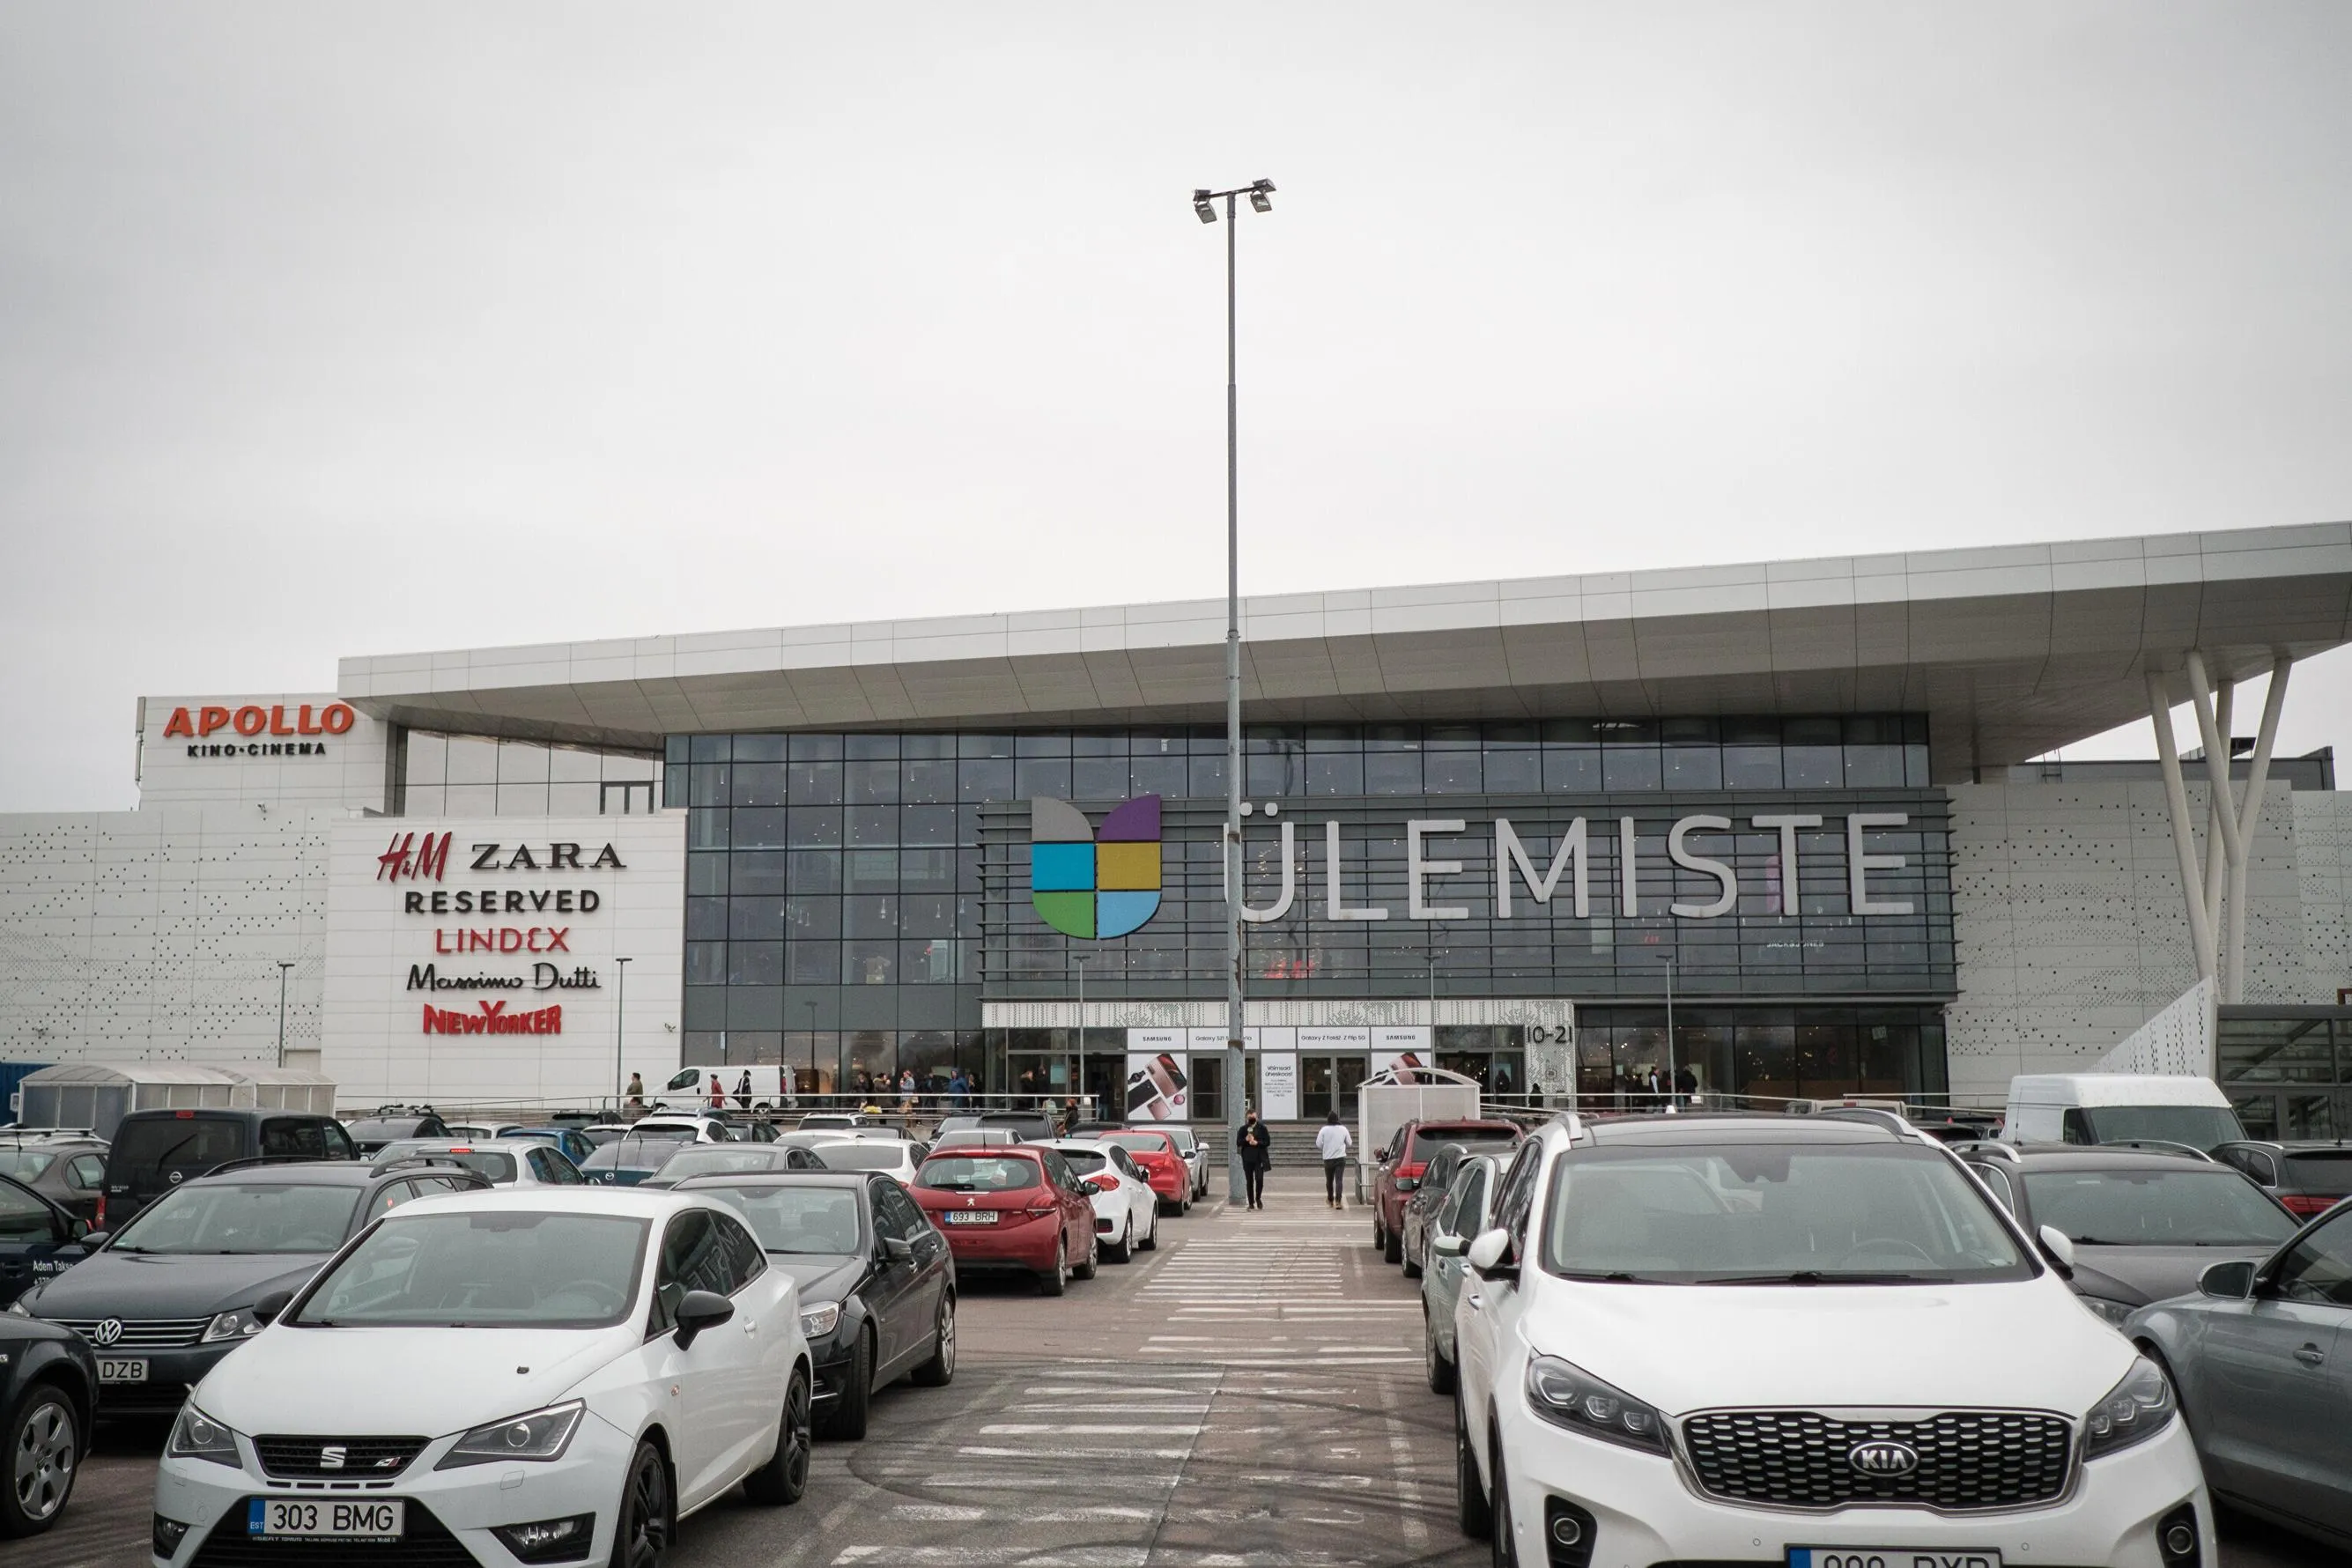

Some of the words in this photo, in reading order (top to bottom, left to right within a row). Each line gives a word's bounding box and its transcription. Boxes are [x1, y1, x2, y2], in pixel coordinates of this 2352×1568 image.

[163, 704, 355, 738] APOLLO
[377, 832, 452, 883] H&M
[470, 842, 627, 869] ZARA
[1224, 802, 1914, 922] ÜLEMISTE
[404, 890, 600, 914] RESERVED
[436, 927, 570, 953] LINDEX
[407, 963, 523, 991] Massimo
[532, 962, 602, 990] Dutti
[1527, 1026, 1572, 1044] 10-21
[953, 1212, 969, 1221] 693
[975, 1212, 995, 1221] BRH
[33, 1260, 53, 1271] Adem
[102, 1362, 143, 1379] DZB
[1861, 1450, 1907, 1468] KIA
[273, 1504, 318, 1530] 303
[333, 1505, 394, 1531] BMG
